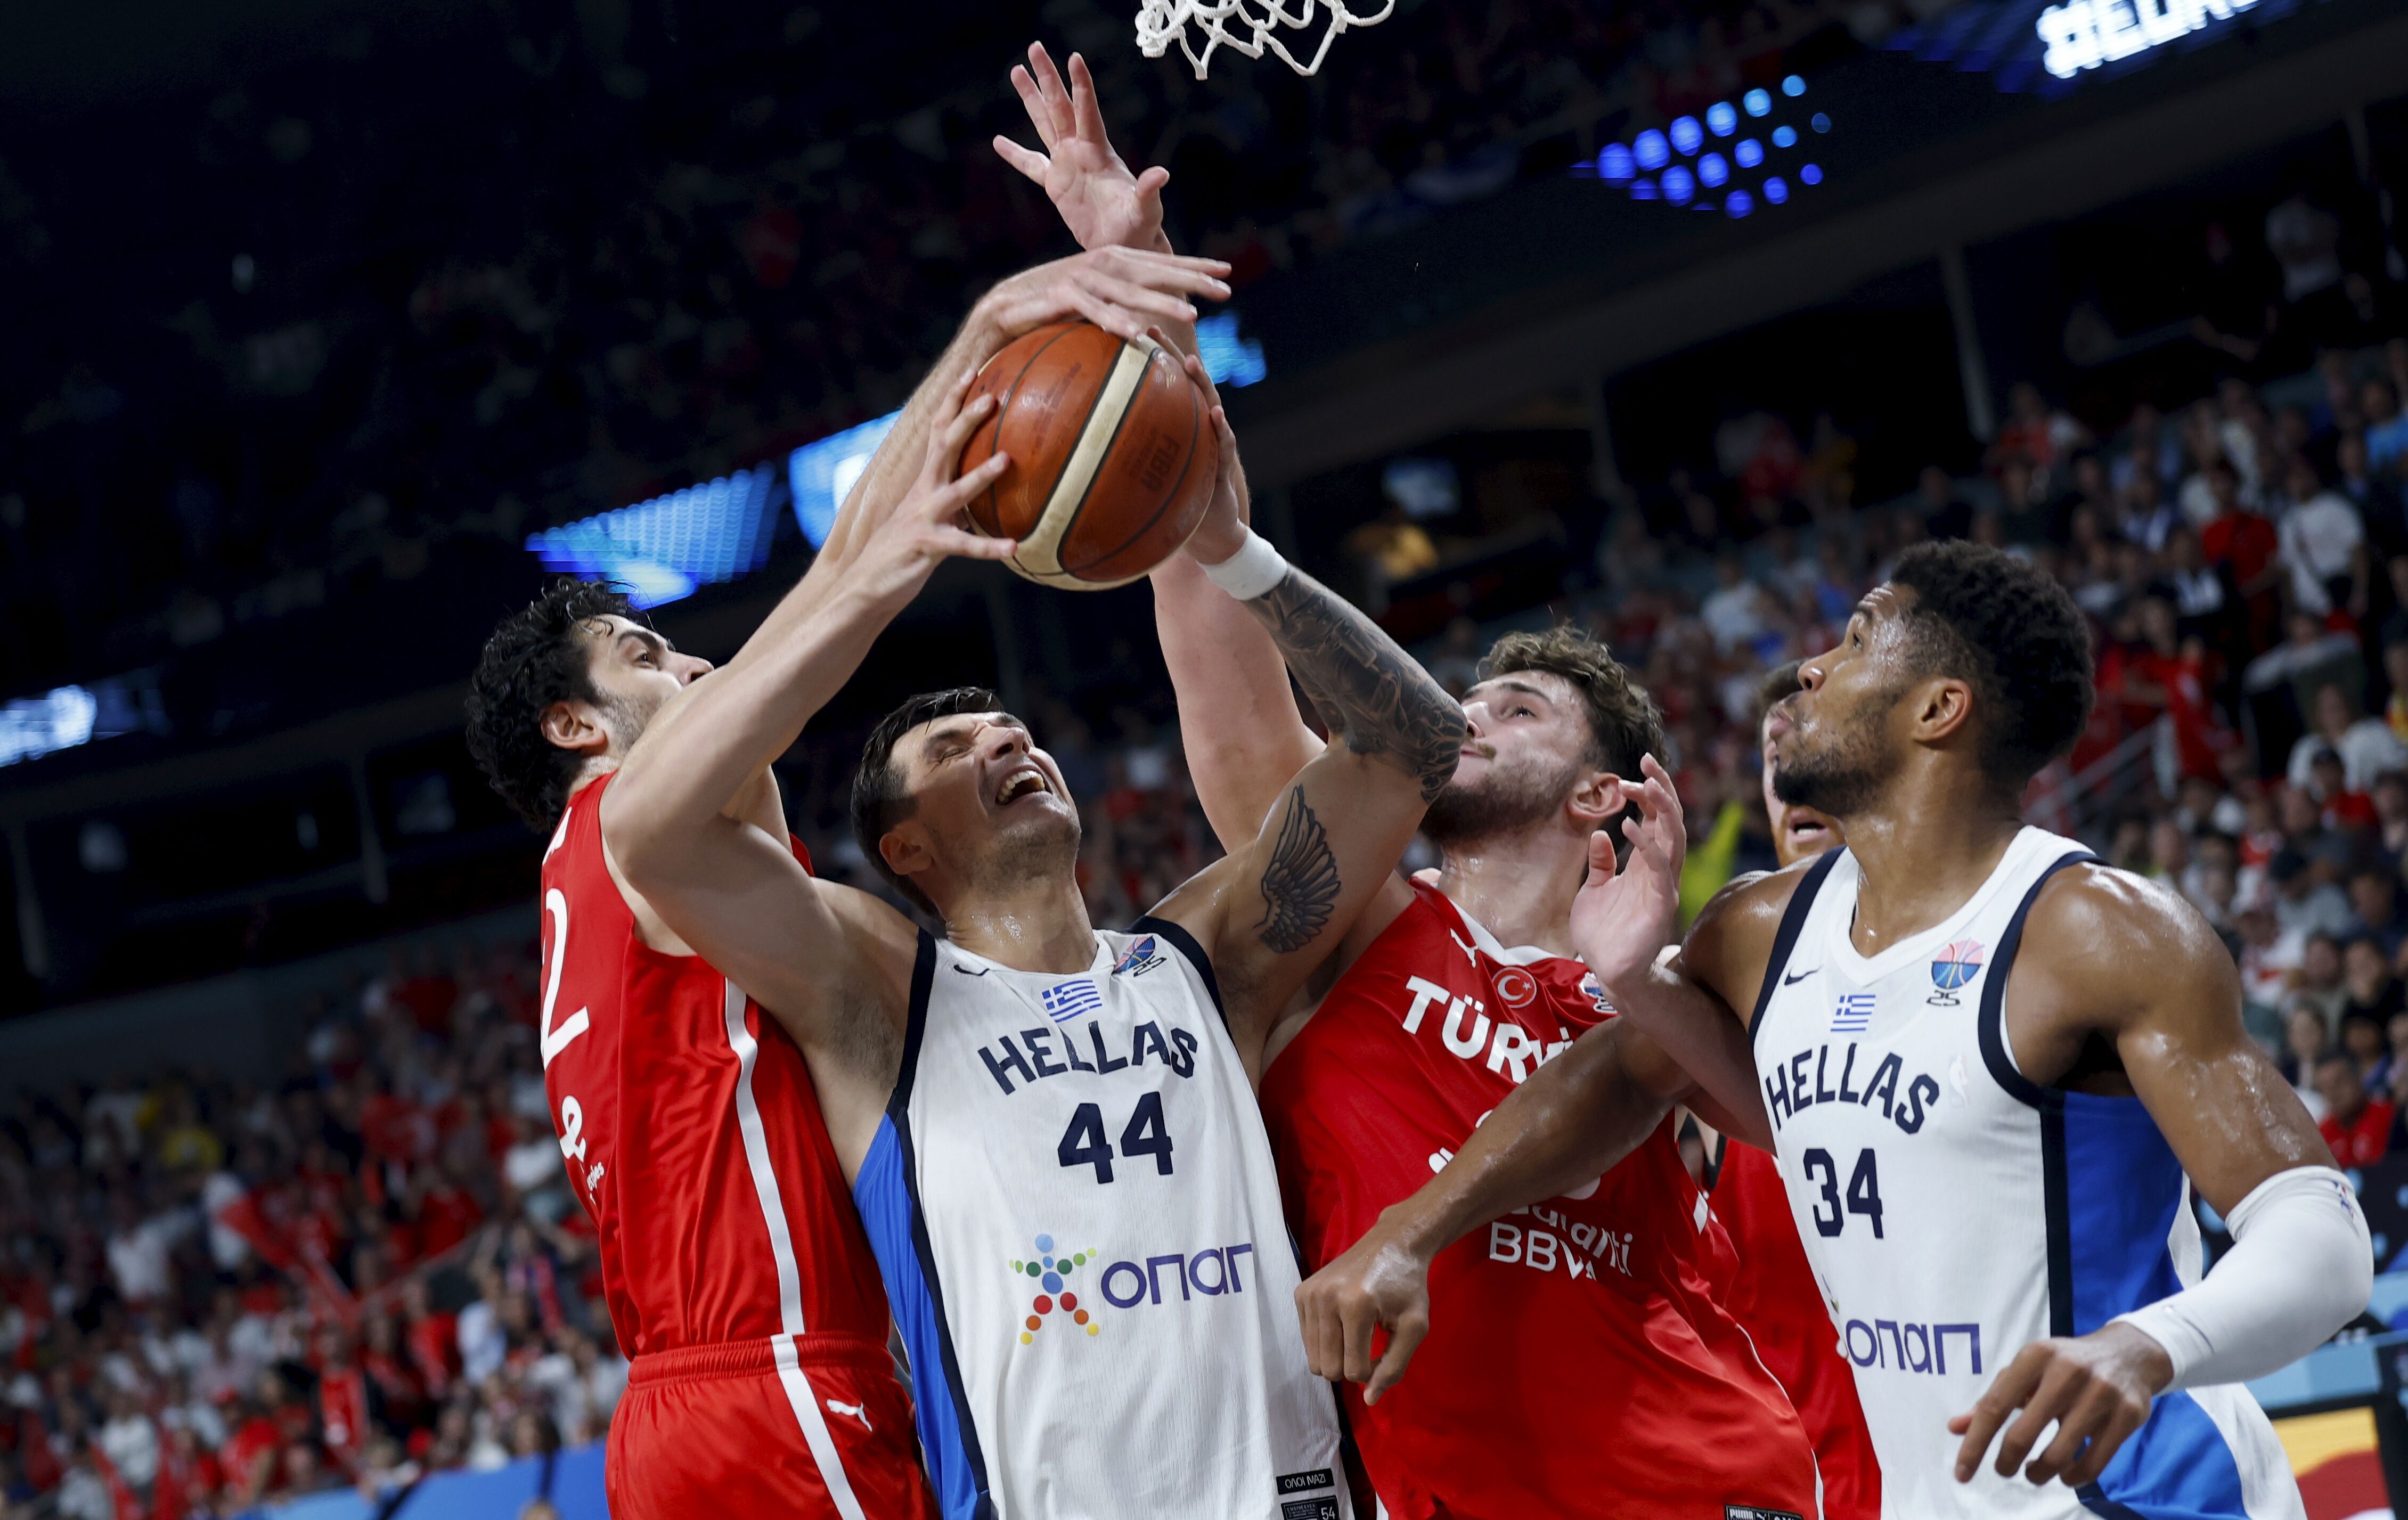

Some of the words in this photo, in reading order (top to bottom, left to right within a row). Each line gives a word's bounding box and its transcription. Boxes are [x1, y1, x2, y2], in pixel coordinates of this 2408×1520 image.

[1140, 434, 1181, 492] FIBA
[978, 1020, 1198, 1095] HELLAS
[1765, 1043, 1940, 1135] HELLAS
[1057, 1091, 1173, 1184] 44
[1803, 1148, 1884, 1239] 34
[1321, 1506, 1336, 1520] 54
